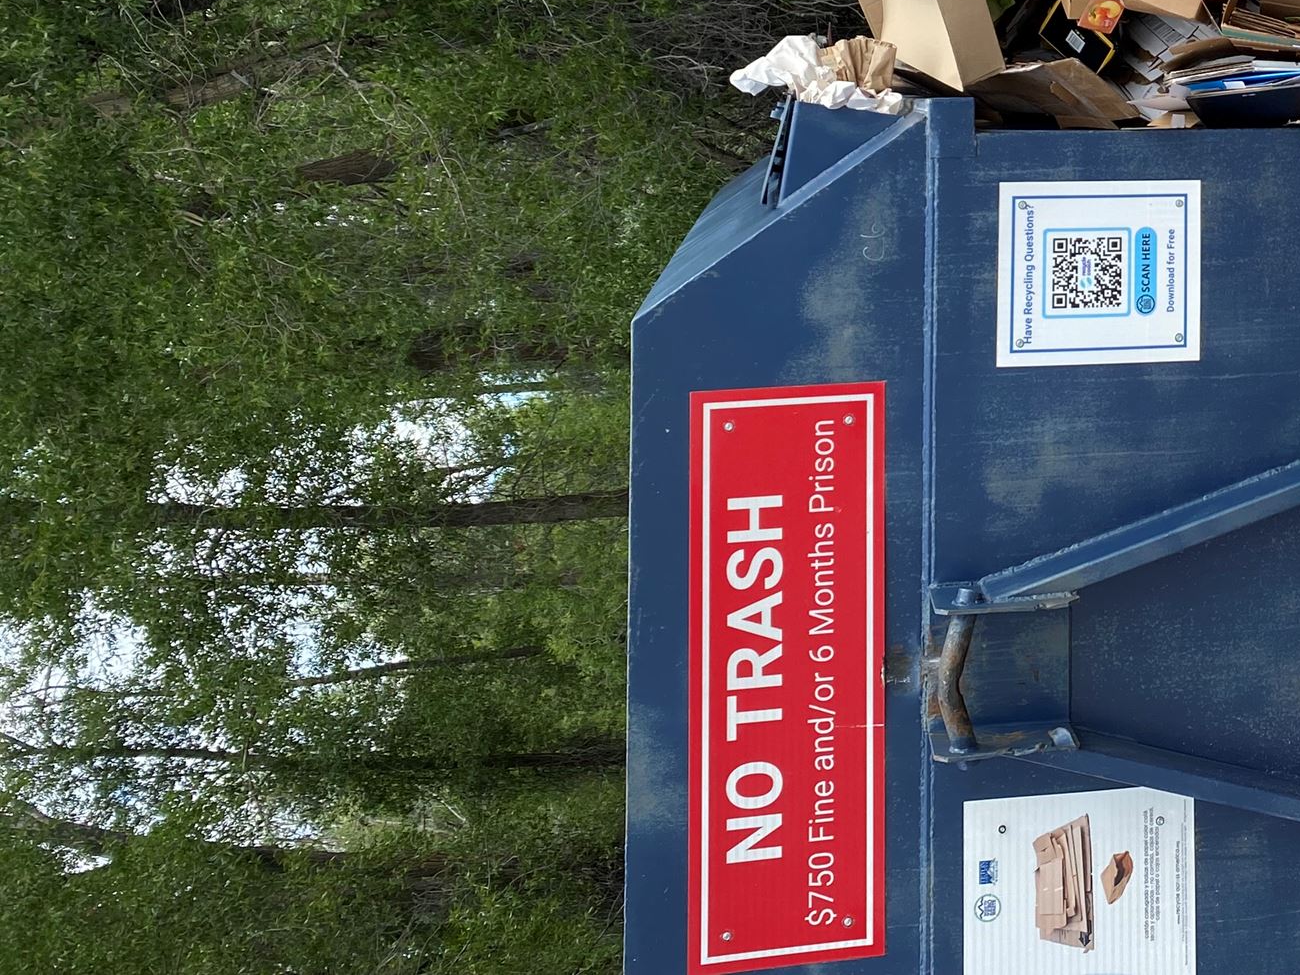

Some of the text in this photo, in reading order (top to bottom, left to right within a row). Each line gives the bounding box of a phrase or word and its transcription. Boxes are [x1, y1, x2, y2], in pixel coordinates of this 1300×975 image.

[1024, 204, 1035, 344] Have Recycling Questions?
[1141, 233, 1151, 261] HERE
[1141, 264, 1151, 293] SCAN
[1166, 229, 1175, 313] Download for Free
[725, 494, 784, 864] NO TRASH
[804, 419, 837, 926] $750 Fine and/or 6 Months Prison
